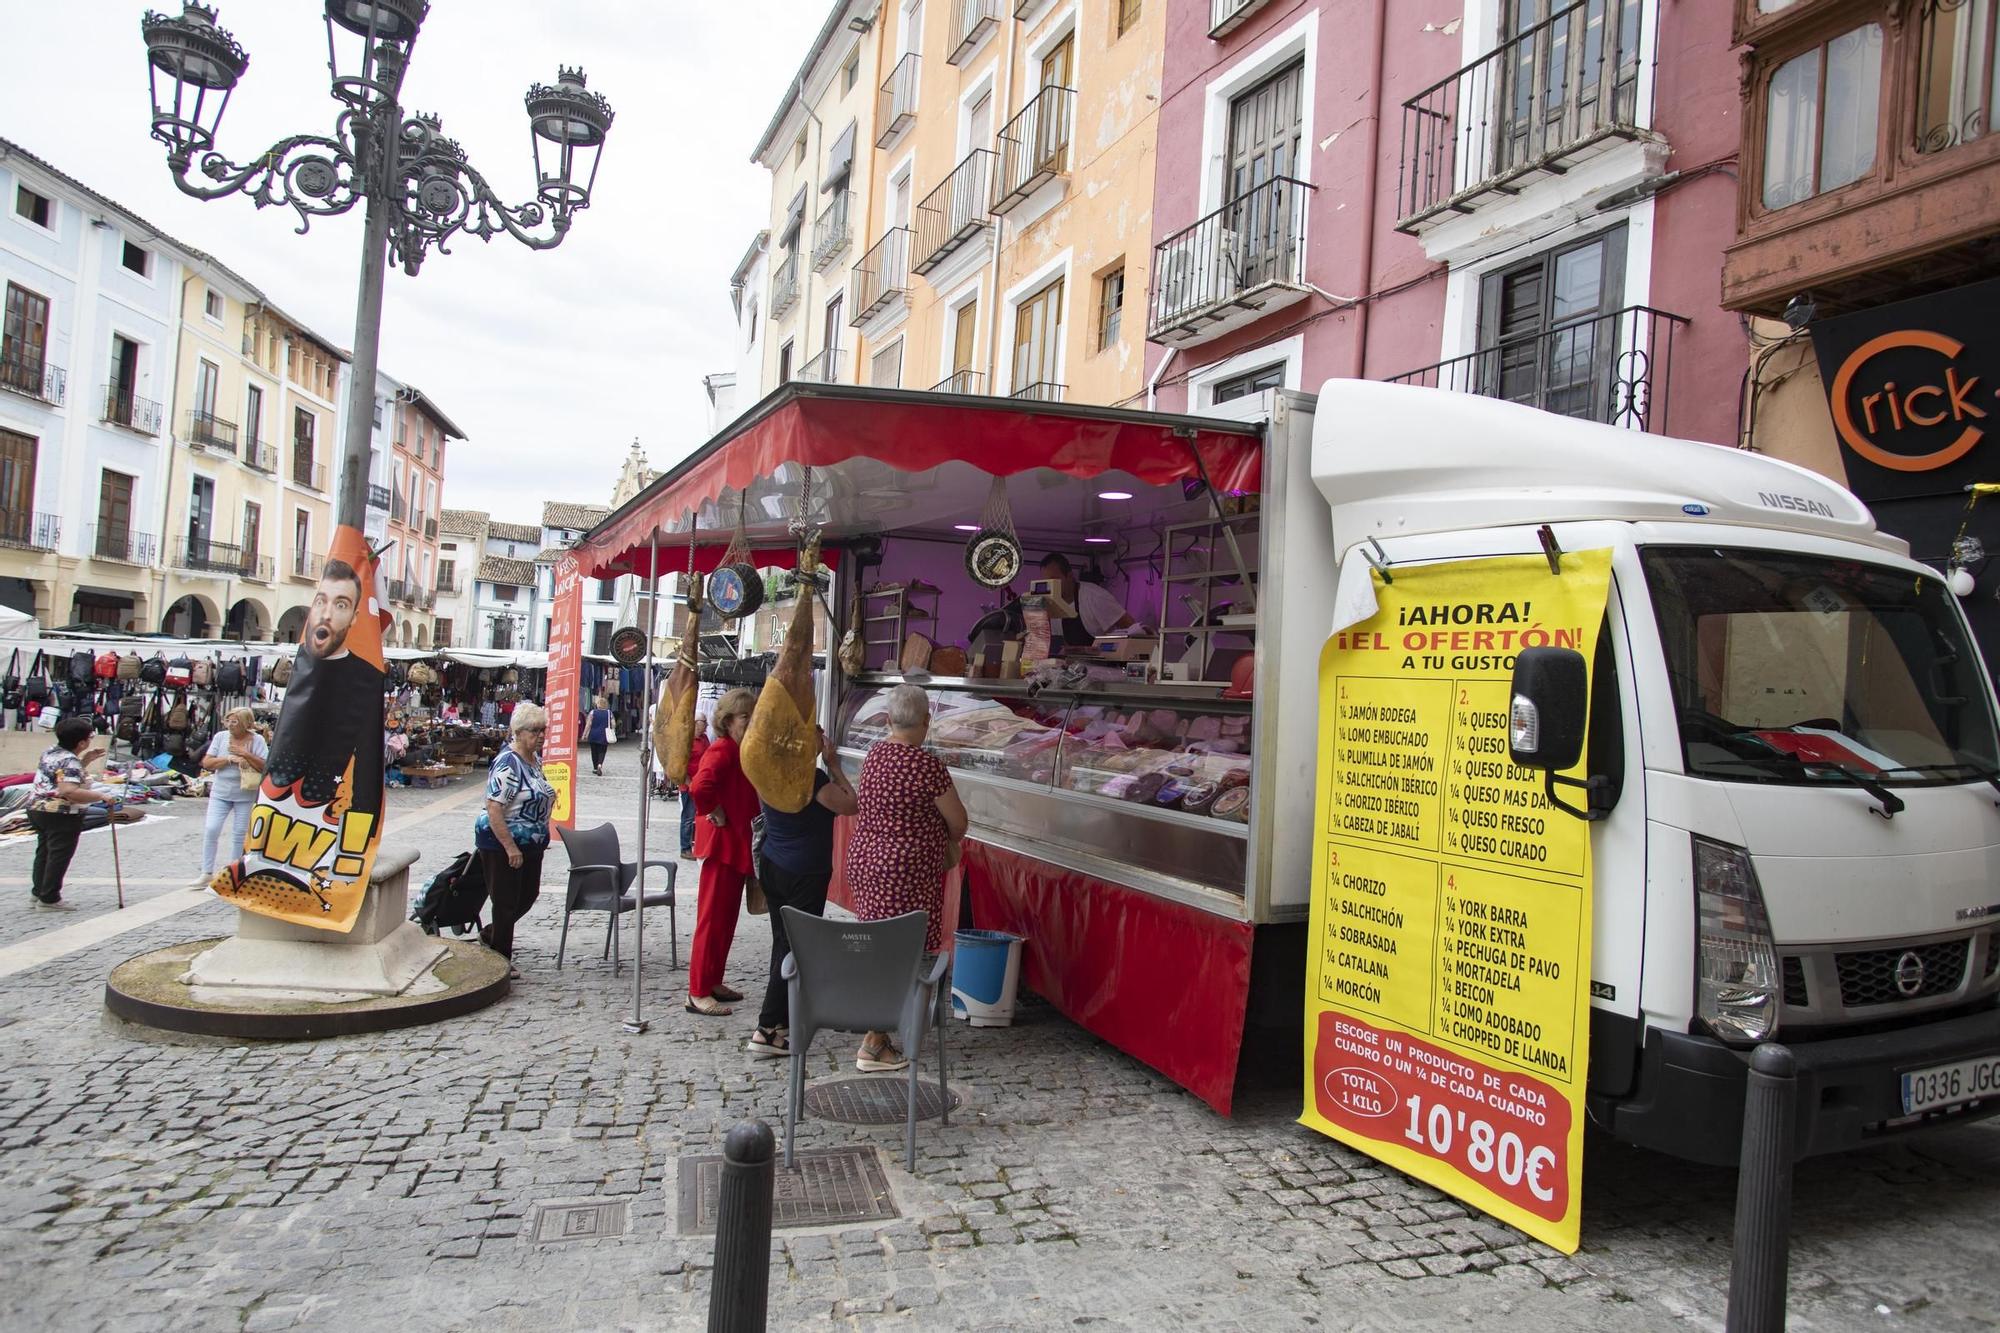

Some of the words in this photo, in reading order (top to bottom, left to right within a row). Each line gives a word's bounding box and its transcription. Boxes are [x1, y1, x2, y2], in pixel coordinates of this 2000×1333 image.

[1831, 329, 1988, 472] Crick
[1758, 491, 1834, 518] NISSAN
[1399, 601, 1531, 626] ¡AHORA!
[1338, 632, 1390, 650] ¡EL
[1402, 623, 1582, 651] OFERTÓN!
[1401, 656, 1415, 669] A
[1422, 656, 1444, 669] TU
[1451, 656, 1517, 670] GUSTO
[1349, 702, 1378, 721] JAMÓN
[1380, 707, 1416, 724] BODEGA
[1470, 712, 1507, 731] QUESO
[1348, 728, 1371, 743] LOMO
[1373, 729, 1429, 748] EMBUCHADO
[1468, 736, 1505, 756] QUESO
[1347, 749, 1387, 767] PLUMILLA
[1390, 753, 1400, 768] DE
[1402, 751, 1434, 772] JAMÓN
[1465, 760, 1503, 780] QUESO
[1506, 764, 1536, 783] BOLA
[1346, 771, 1399, 791] SALCHICHÓN
[1401, 773, 1438, 796] IBÉRICO
[1463, 784, 1500, 804] QUESO
[1503, 789, 1528, 807] MAS
[1344, 793, 1382, 812] CHORIZO
[1384, 795, 1420, 818] IBÉRICO
[1343, 815, 1374, 833] CABEZA
[1377, 820, 1388, 836] DE
[1390, 821, 1420, 841] JABALÍ
[1462, 809, 1498, 829] QUESO
[1501, 814, 1545, 835] FRESCO
[1460, 833, 1497, 853] QUESO
[1500, 839, 1547, 862] CURADO
[1343, 874, 1386, 897] CHORIZO
[1341, 900, 1404, 929] SALCHICHÓN
[1459, 898, 1487, 920] YORK
[1490, 905, 1528, 929] BARRA
[841, 933, 872, 941] AMSTEL
[1339, 926, 1397, 955] SOBRASADA
[1458, 919, 1487, 941] YORK
[1490, 926, 1526, 950] EXTRA
[1338, 952, 1389, 980] CATALANA
[1456, 939, 1507, 967] PECHUGA
[1510, 952, 1526, 971] DE
[1529, 956, 1560, 980] PAVO
[1456, 960, 1521, 992] MORTADELA
[1336, 977, 1381, 1004] MORCÓN
[1455, 980, 1494, 1006] BEICON
[1454, 1000, 1483, 1024] LOMO
[1485, 1010, 1541, 1042] ADOBADO
[1453, 1021, 1501, 1051] CHOPPED
[1504, 1037, 1520, 1057] DE
[1522, 1043, 1567, 1074] LLANDA
[1335, 1021, 1379, 1045] ESCOGE
[1385, 1037, 1402, 1053] UN
[1408, 1046, 1475, 1081] PRODUCTO
[1483, 1072, 1501, 1090] DE
[1509, 1083, 1547, 1108] CADA
[1334, 1037, 1380, 1062] CUADRO
[1383, 1054, 1392, 1067] O
[1395, 1058, 1412, 1075] UN
[1430, 1071, 1447, 1088] DE
[1449, 1080, 1485, 1103] CADA
[1488, 1095, 1546, 1127] CUADRO
[1341, 1072, 1380, 1095] TOTAL
[1915, 1068, 1960, 1105] 0336
[1342, 1091, 1349, 1104] 1
[1352, 1093, 1382, 1113] KILO
